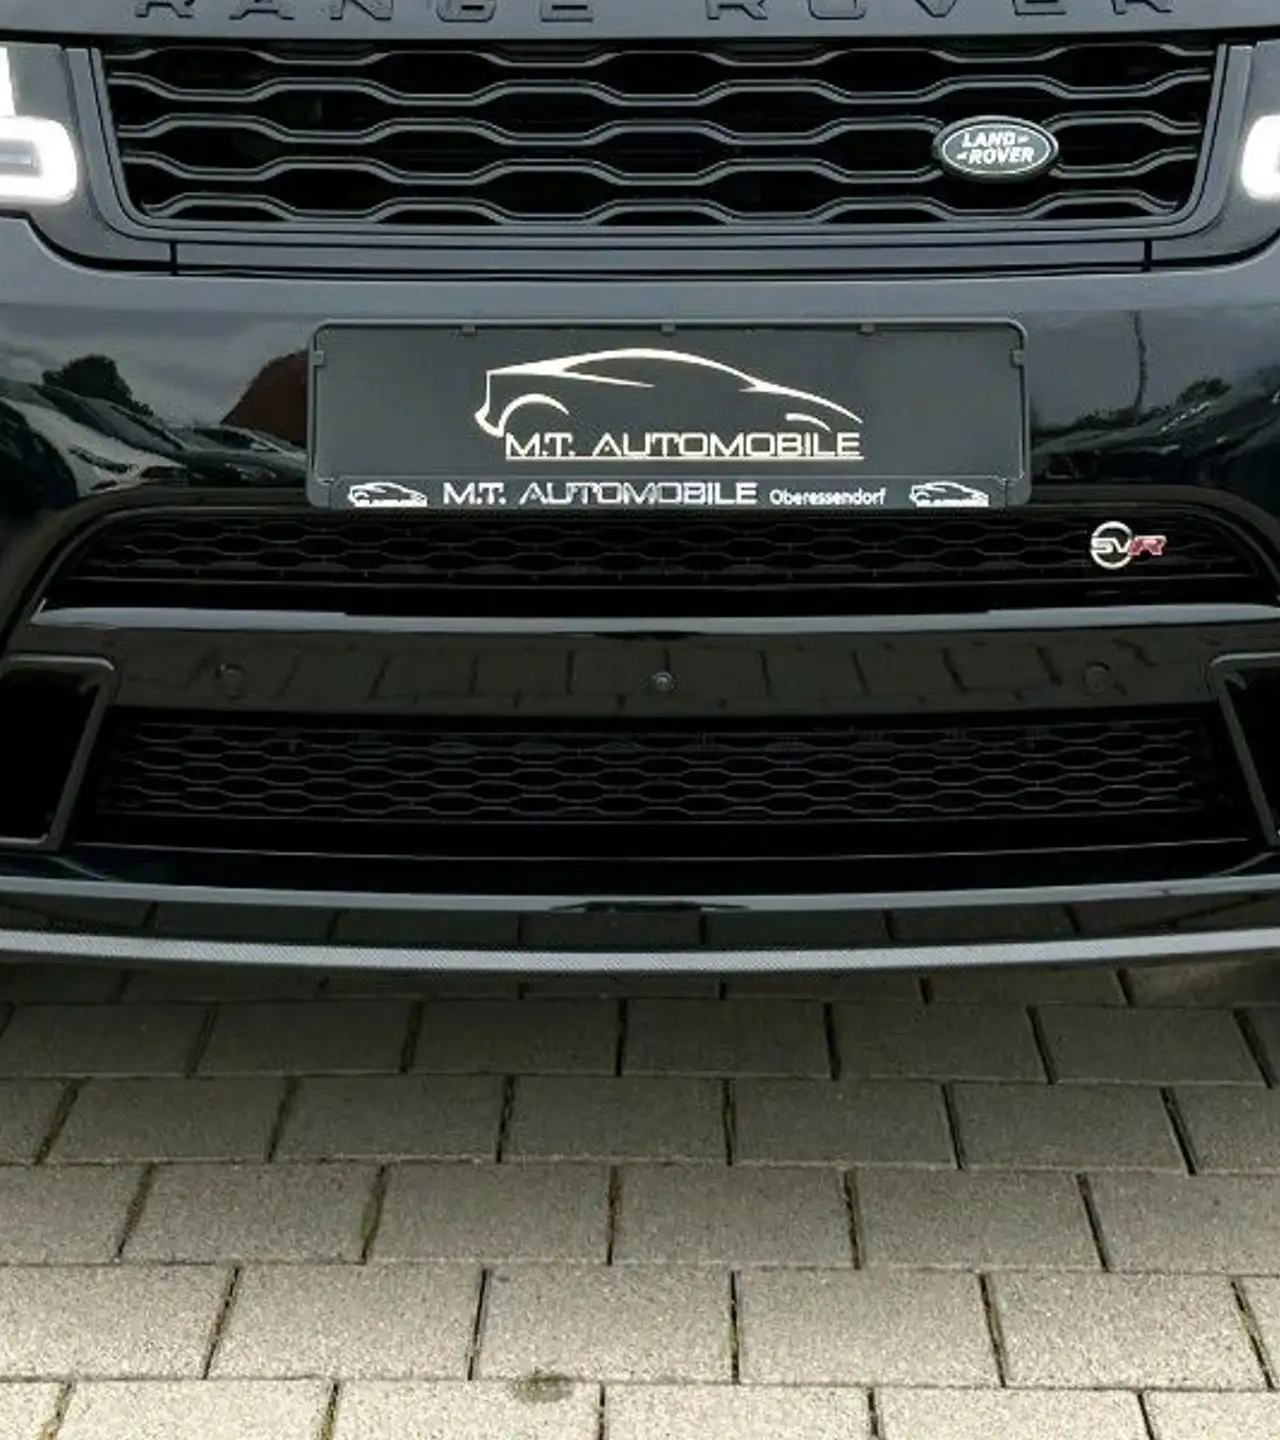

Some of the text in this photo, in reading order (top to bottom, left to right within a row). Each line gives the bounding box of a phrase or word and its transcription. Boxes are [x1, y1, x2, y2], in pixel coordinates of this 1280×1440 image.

[961, 131, 1018, 149] LAND
[967, 145, 1037, 165] ROVER
[503, 432, 861, 457] M.T. AUTOMOBILE
[442, 481, 508, 505] M.T.
[518, 481, 759, 505] AUTOMOBILE
[768, 486, 888, 507] Oberessendorf
[1089, 532, 1168, 559] SVR
